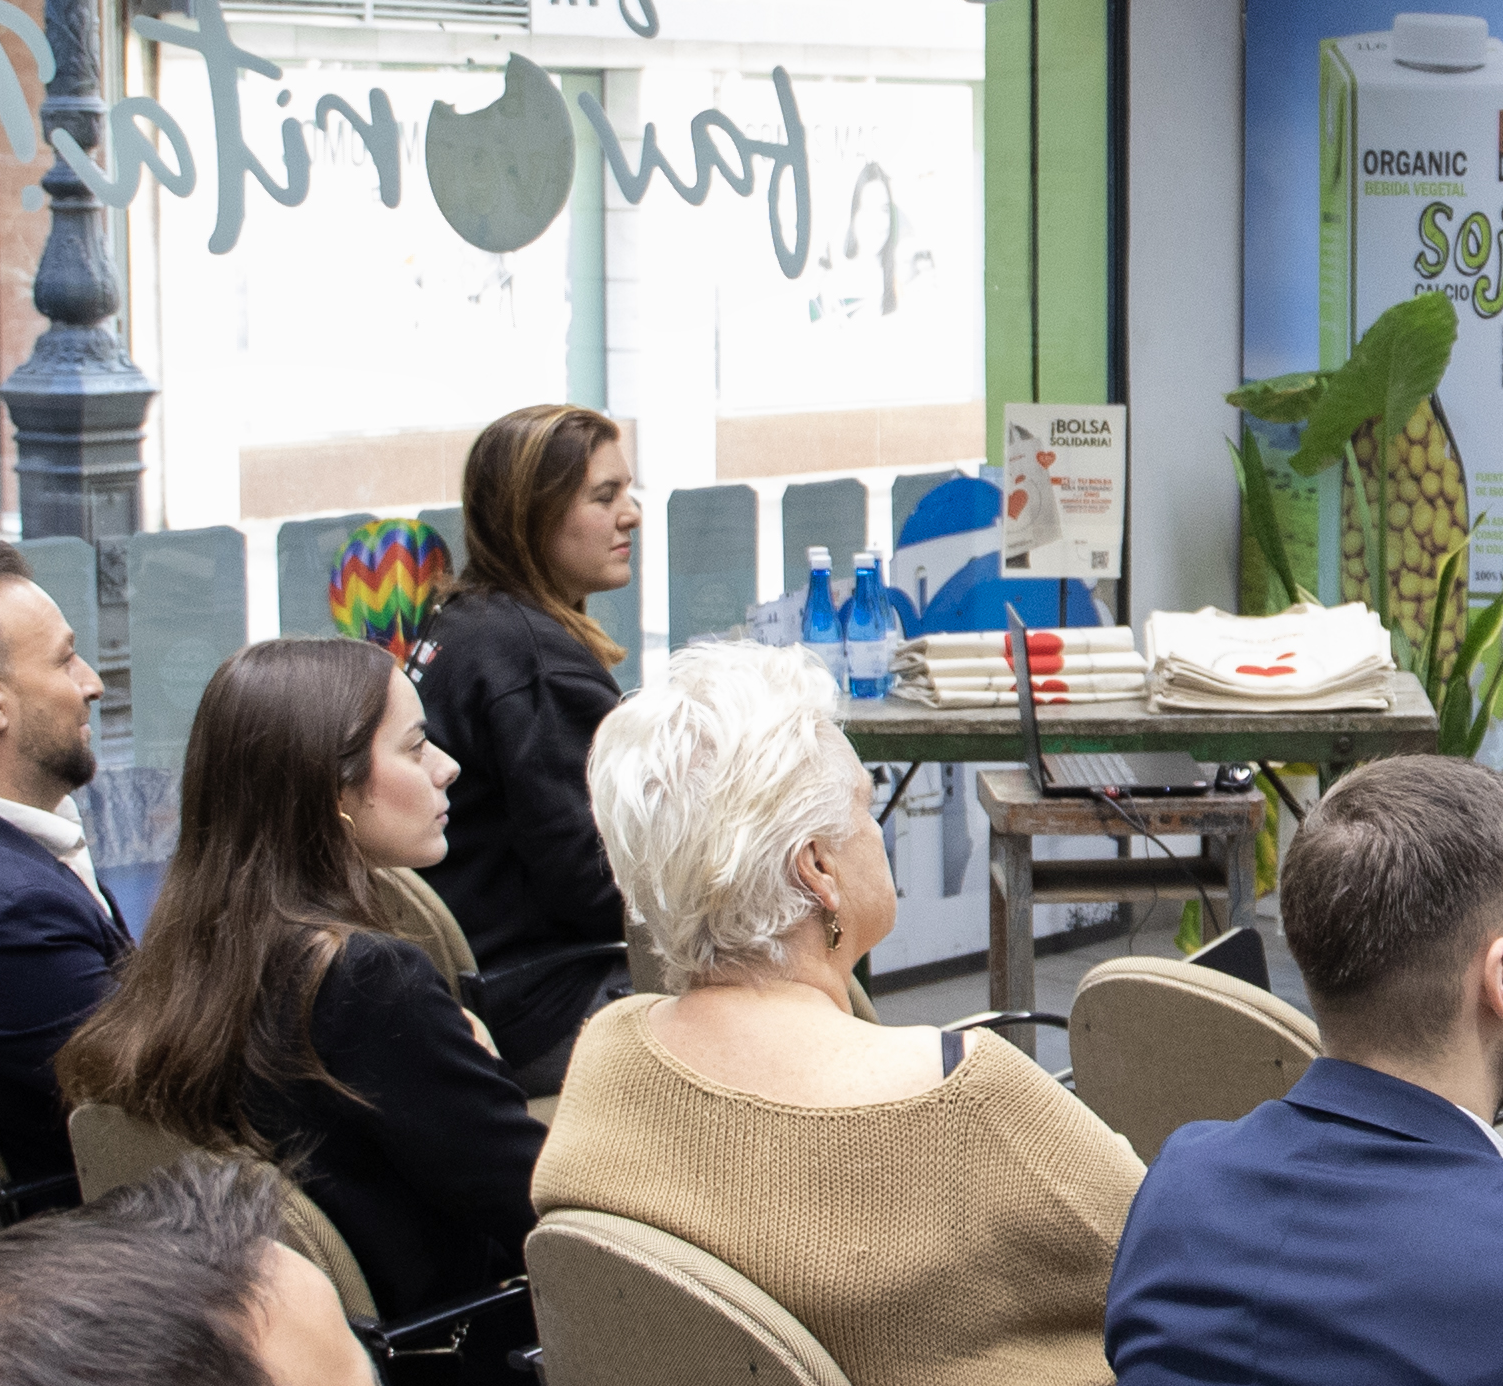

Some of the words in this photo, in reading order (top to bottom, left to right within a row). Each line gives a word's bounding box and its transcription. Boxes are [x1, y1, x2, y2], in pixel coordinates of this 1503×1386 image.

[1363, 150, 1468, 177] ORGANIC
[1364, 180, 1409, 196] BEBIDA
[1413, 182, 1467, 197] VEGETAL
